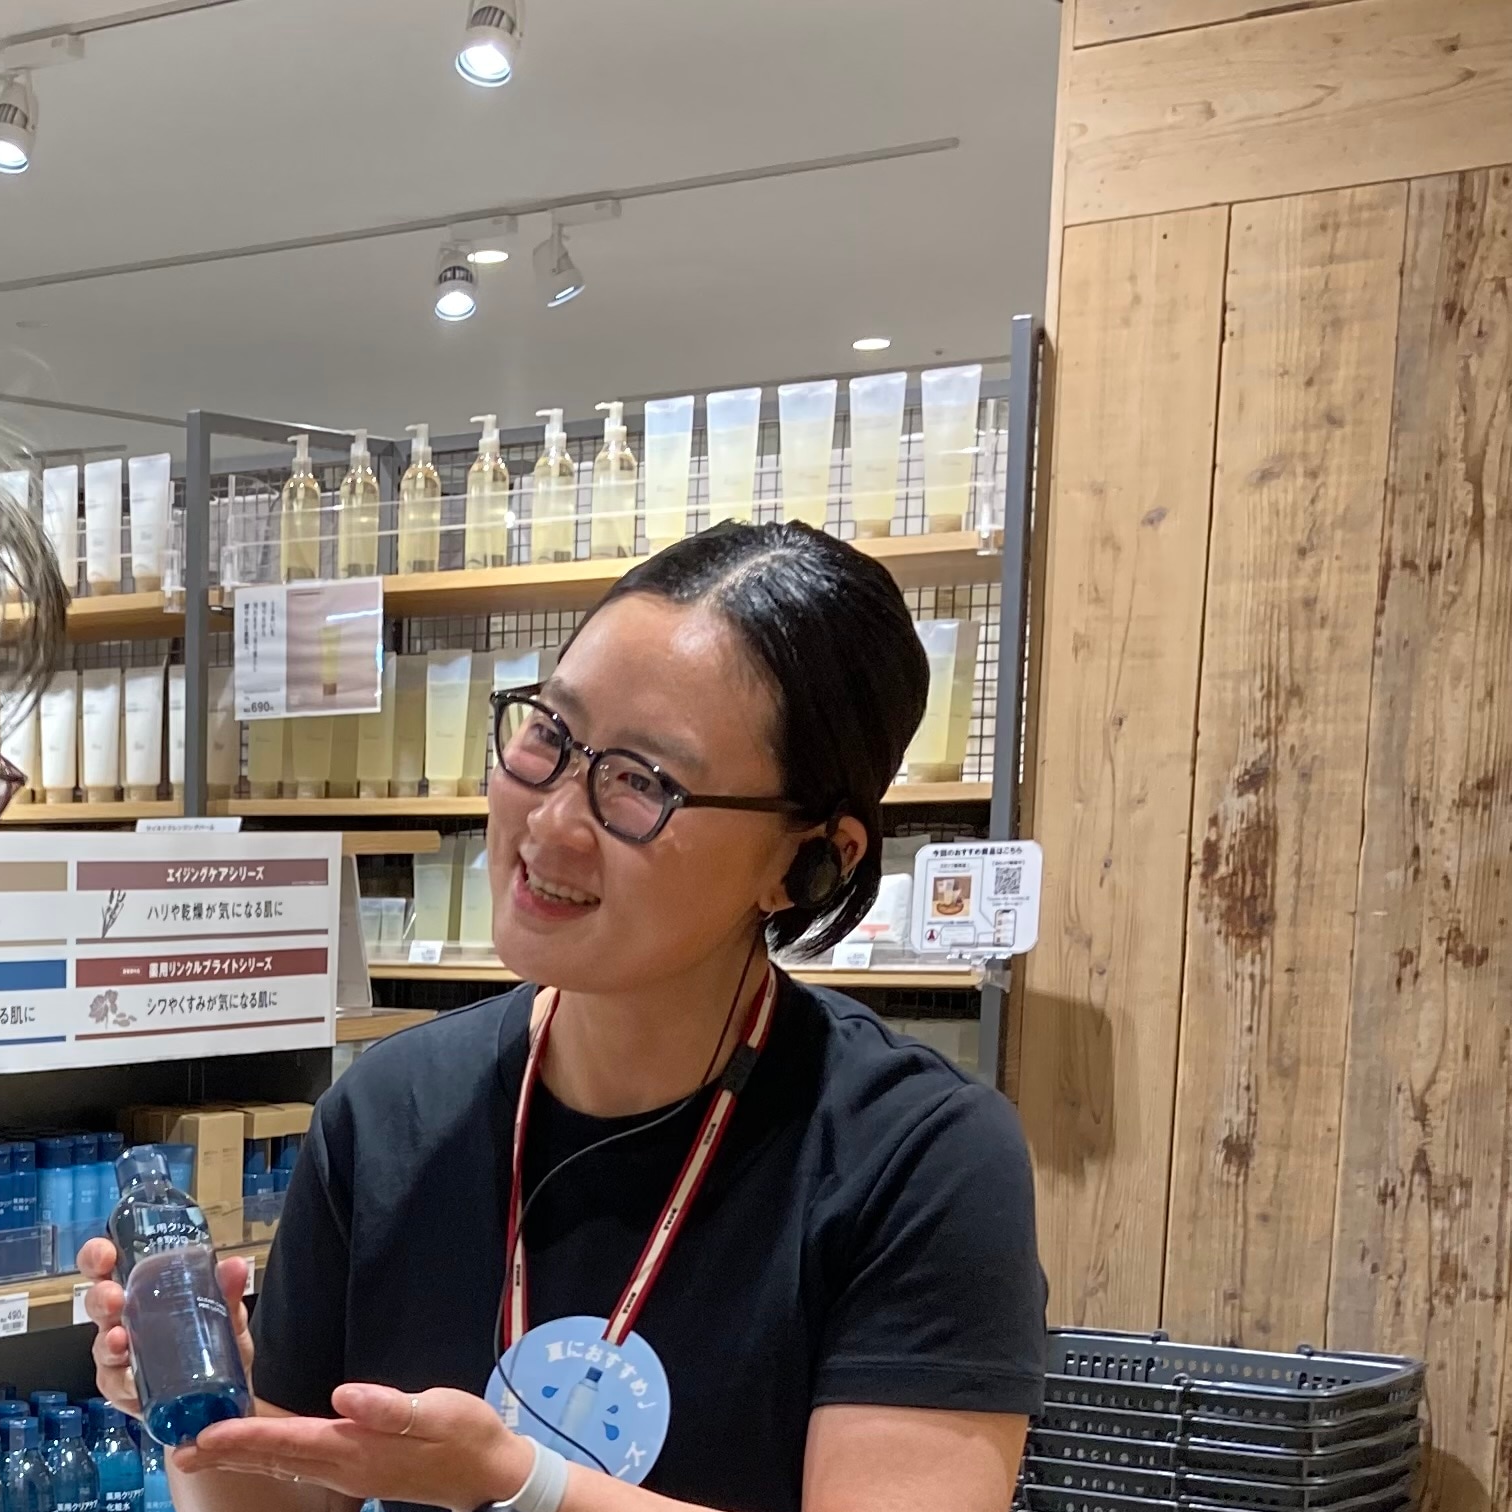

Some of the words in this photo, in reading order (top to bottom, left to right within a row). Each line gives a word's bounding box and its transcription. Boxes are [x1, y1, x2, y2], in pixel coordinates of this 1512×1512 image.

[166, 866, 265, 883] エイジングケアシリーズ
[147, 900, 284, 921] ハリや乾燥が気になる肌に
[148, 956, 274, 979] 薬用リンクルブライトシリーズ
[146, 991, 278, 1016] シワやくすみが気になる肌に
